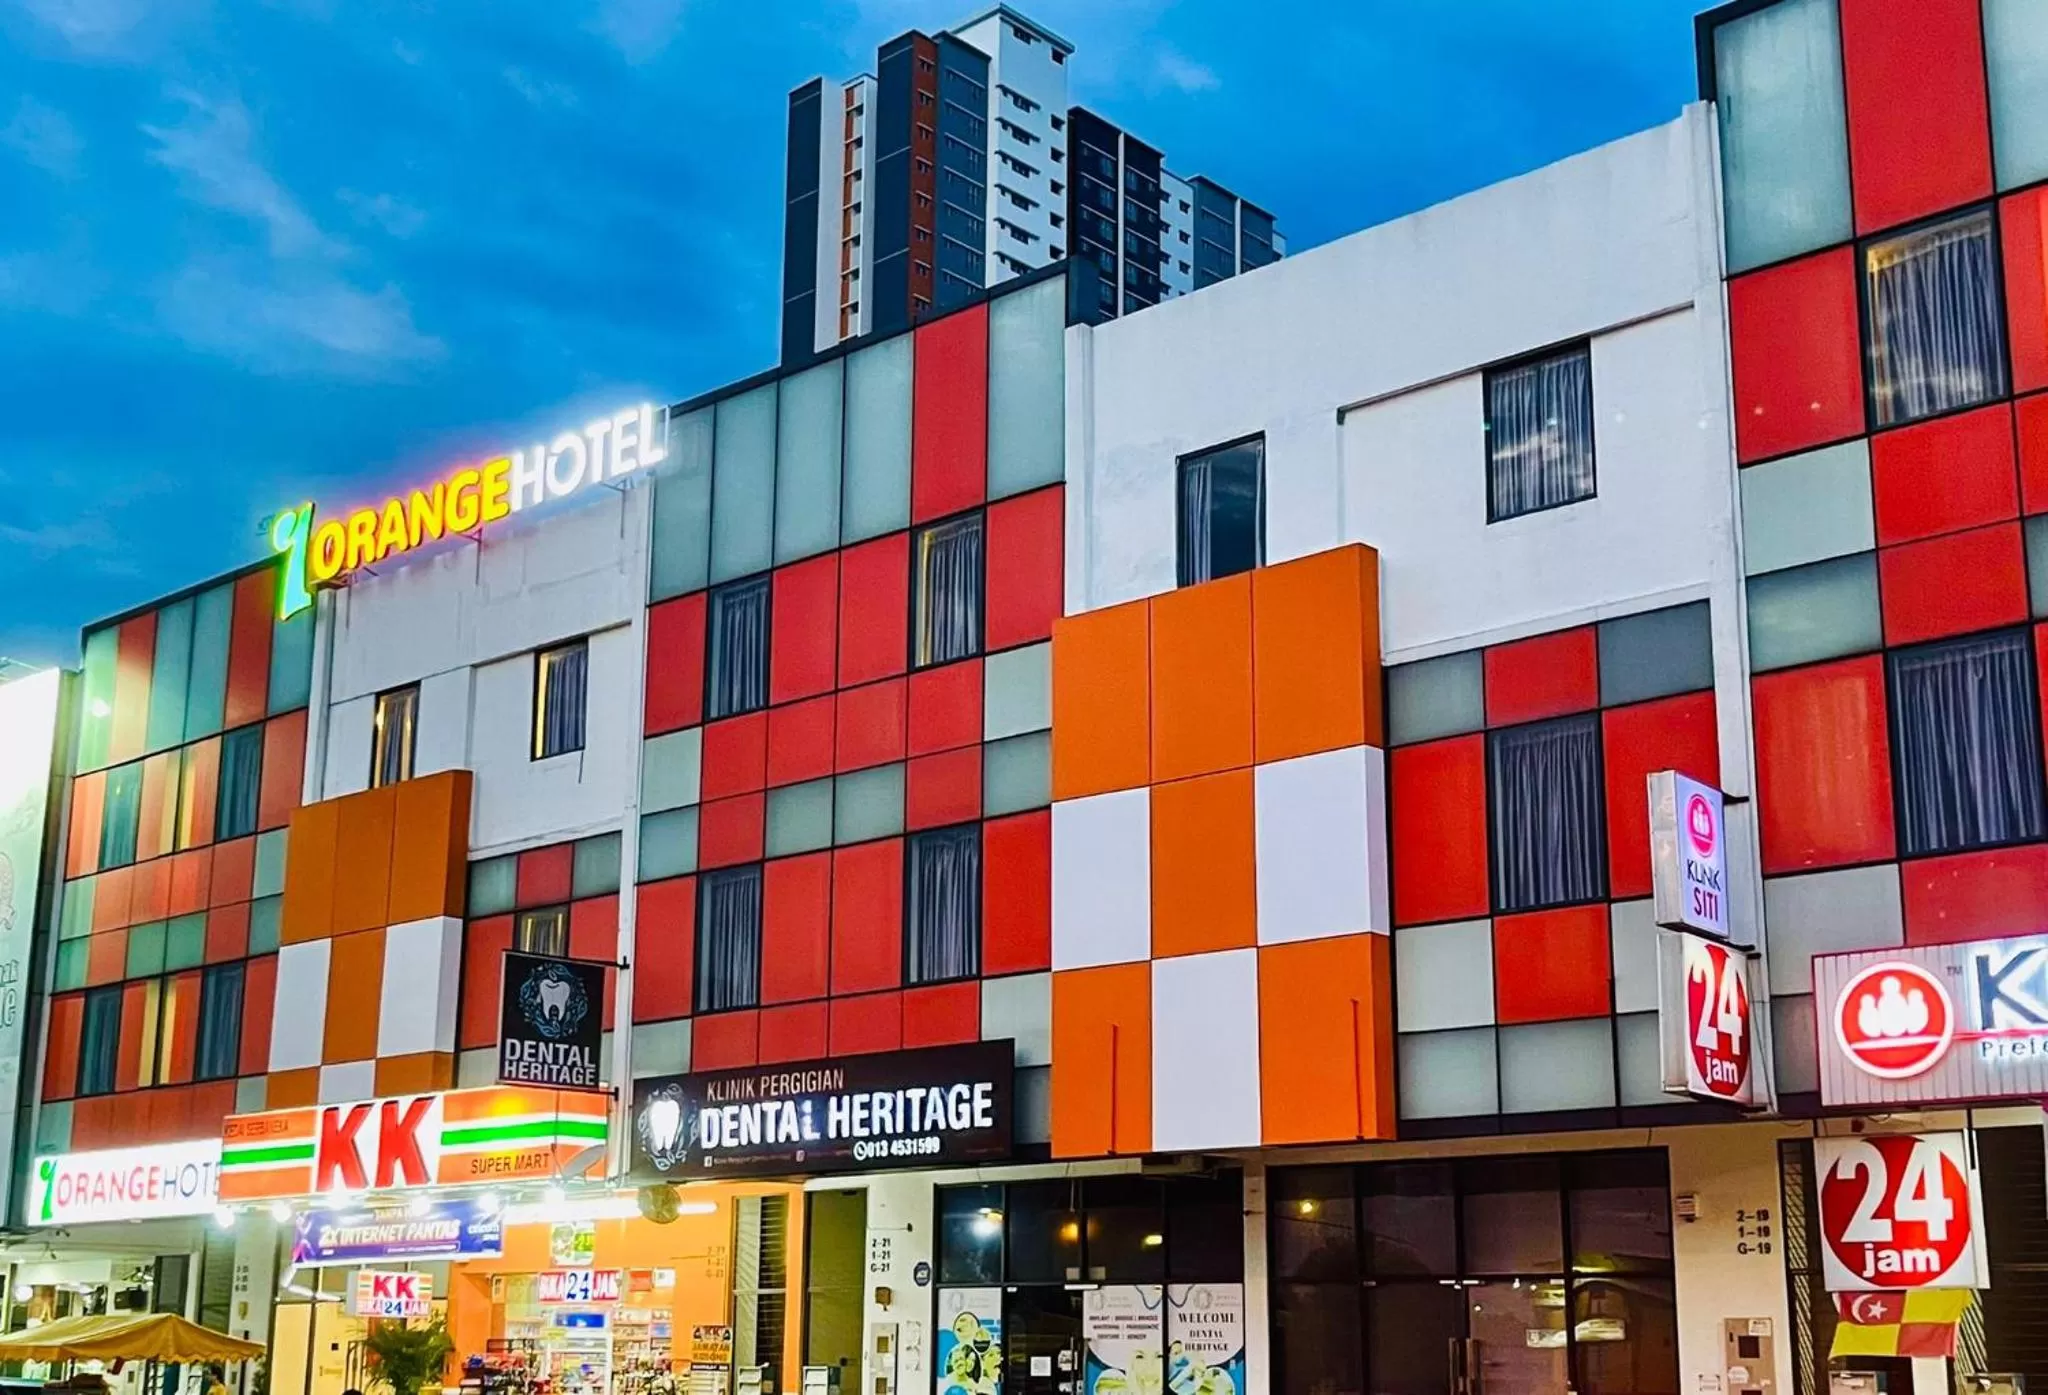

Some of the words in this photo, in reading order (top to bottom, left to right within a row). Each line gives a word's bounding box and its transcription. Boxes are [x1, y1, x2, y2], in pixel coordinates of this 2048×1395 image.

[1693, 888, 1719, 922] SITI
[1689, 944, 1744, 1056] 24
[505, 1037, 596, 1069] DENTAL
[1704, 1050, 1739, 1086] jam
[503, 1060, 597, 1086] HERITAGE
[707, 1076, 756, 1101] KLINIK
[760, 1069, 844, 1098] PERGIGIAN
[700, 1099, 821, 1149] DENTAL
[828, 1082, 994, 1139] HERITAGE
[315, 1095, 438, 1193] KK
[471, 1156, 512, 1174] SUPER
[513, 1152, 551, 1171] MART
[1836, 1137, 1954, 1242] 24
[1736, 1242, 1772, 1255] G-19
[1861, 1243, 1941, 1278] jam
[373, 1274, 417, 1299] KK
[566, 1272, 590, 1300] 24
[384, 1301, 403, 1314] 24
